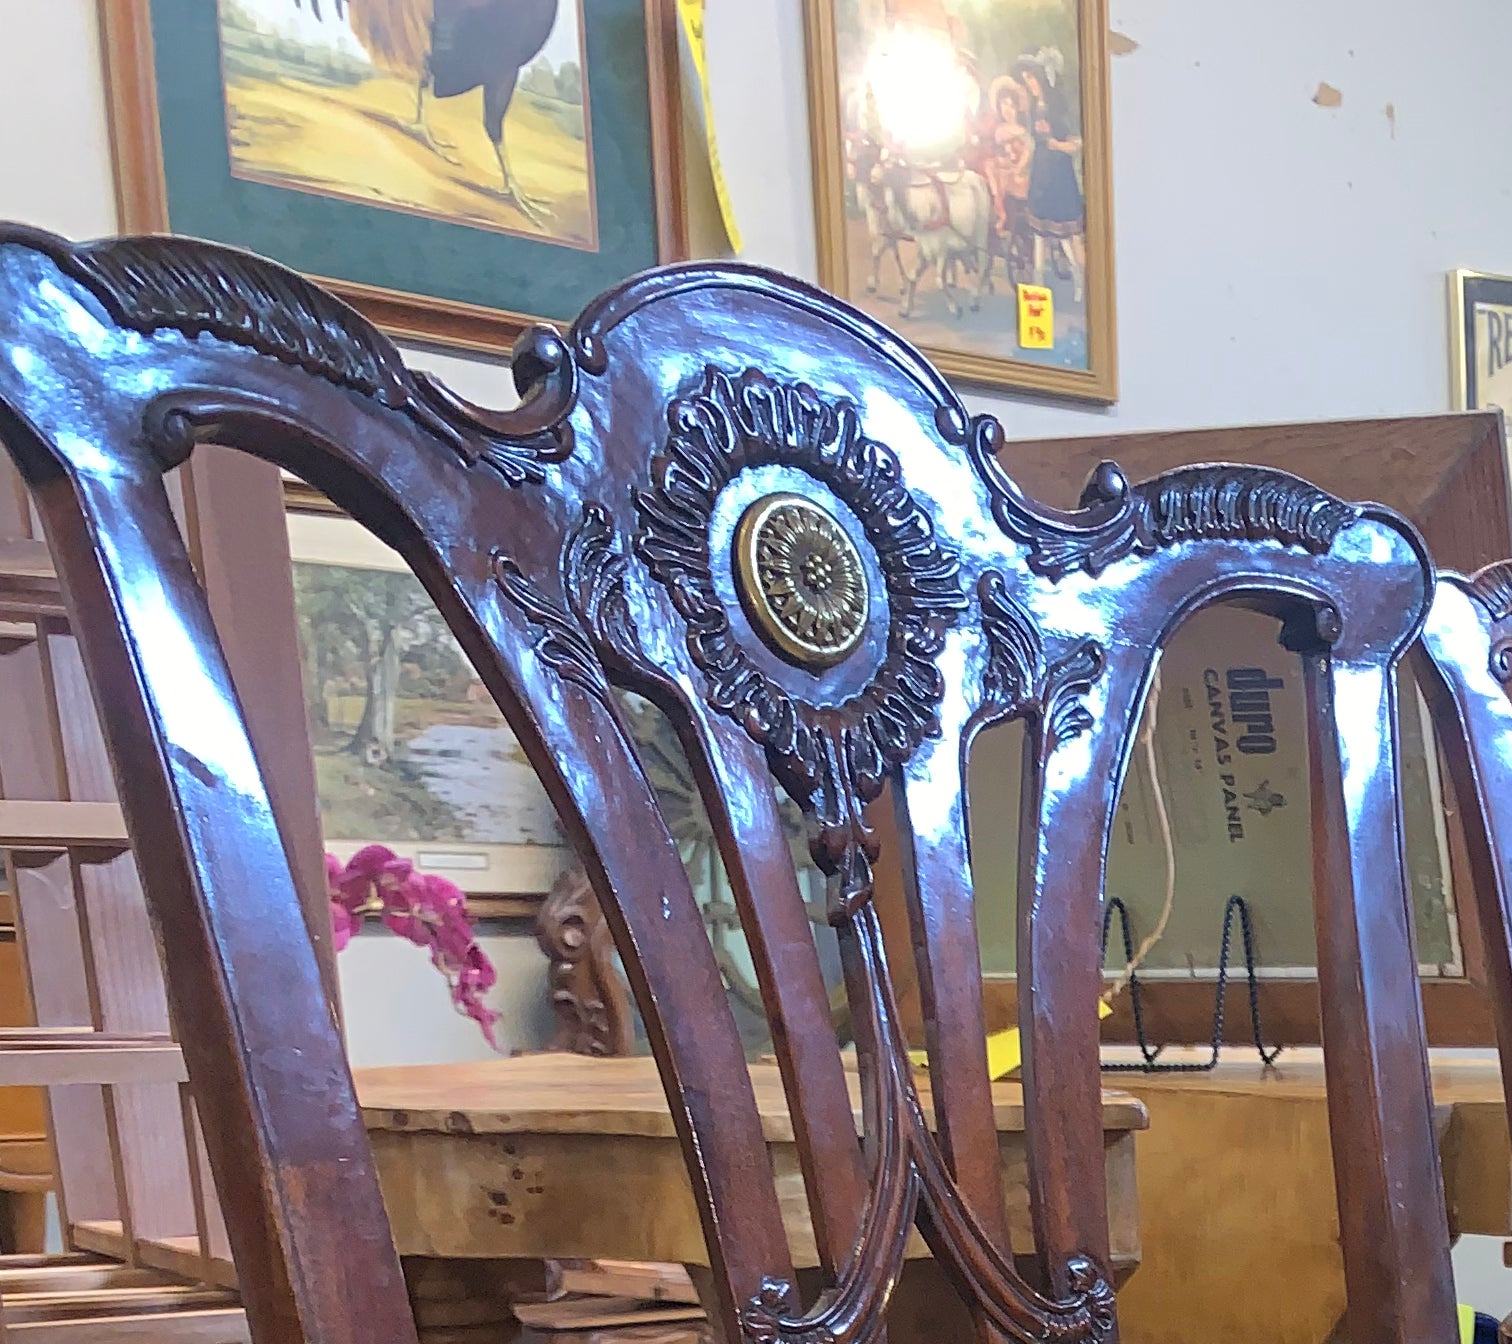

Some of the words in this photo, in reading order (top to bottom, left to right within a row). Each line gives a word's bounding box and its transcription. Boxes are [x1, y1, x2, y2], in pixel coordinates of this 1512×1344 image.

[1202, 668, 1232, 767] CANVAS
[1220, 773, 1245, 843] PANEL
[1226, 668, 1285, 755] duro
